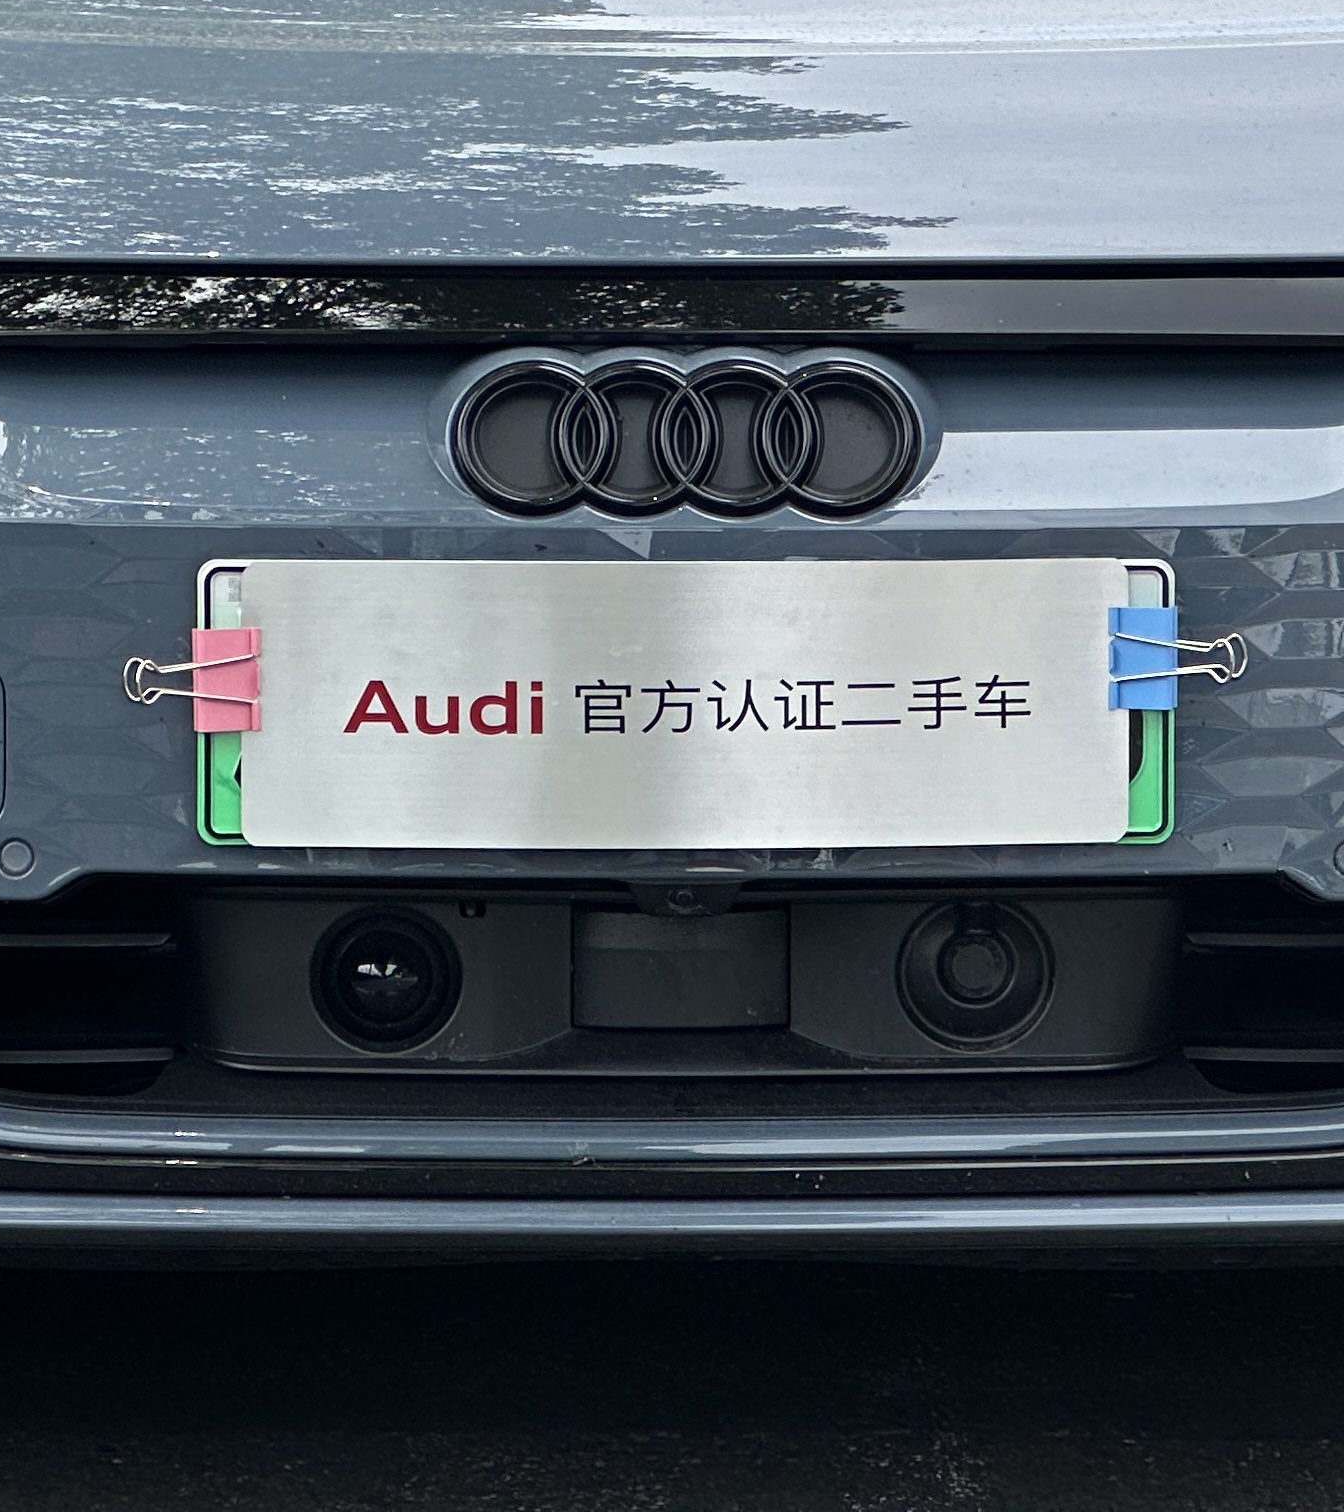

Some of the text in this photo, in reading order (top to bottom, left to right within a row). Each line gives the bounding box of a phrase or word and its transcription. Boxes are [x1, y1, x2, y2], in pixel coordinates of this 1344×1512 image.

[343, 674, 1032, 735] Audi 官方认证二手车
